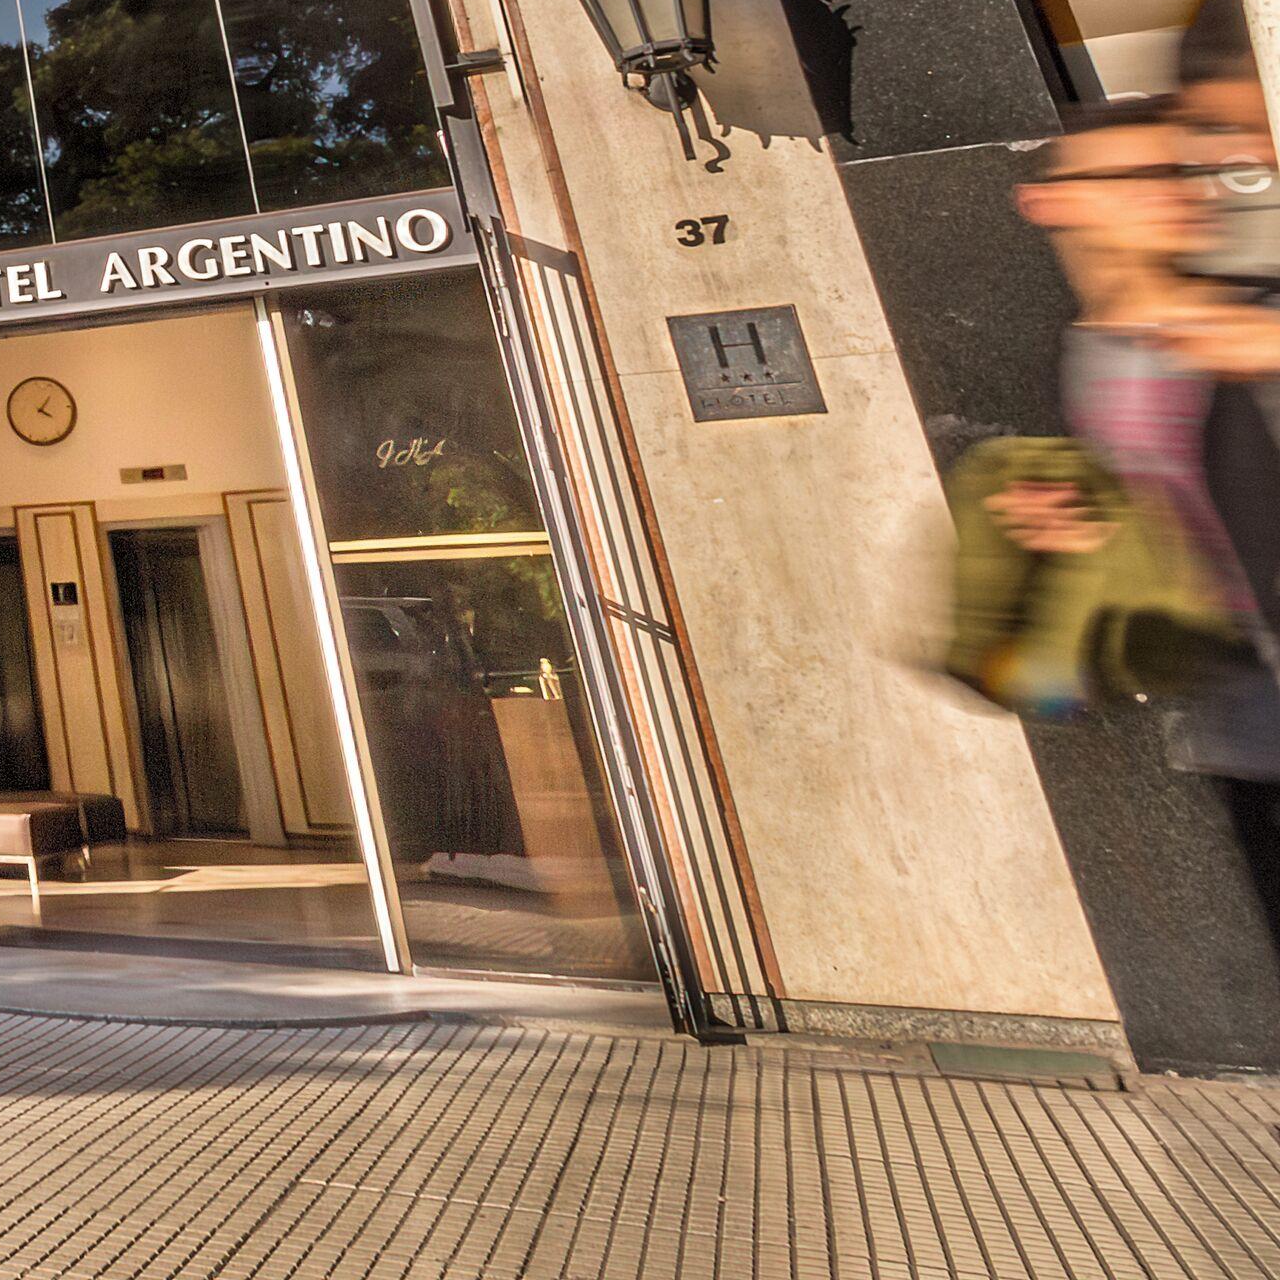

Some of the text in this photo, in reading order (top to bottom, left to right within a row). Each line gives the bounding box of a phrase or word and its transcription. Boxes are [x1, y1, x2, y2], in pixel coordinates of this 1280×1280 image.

[100, 208, 448, 293] ARGENTINO
[674, 214, 730, 247] 37
[708, 322, 768, 369] H
[700, 390, 793, 409] HOTEL
